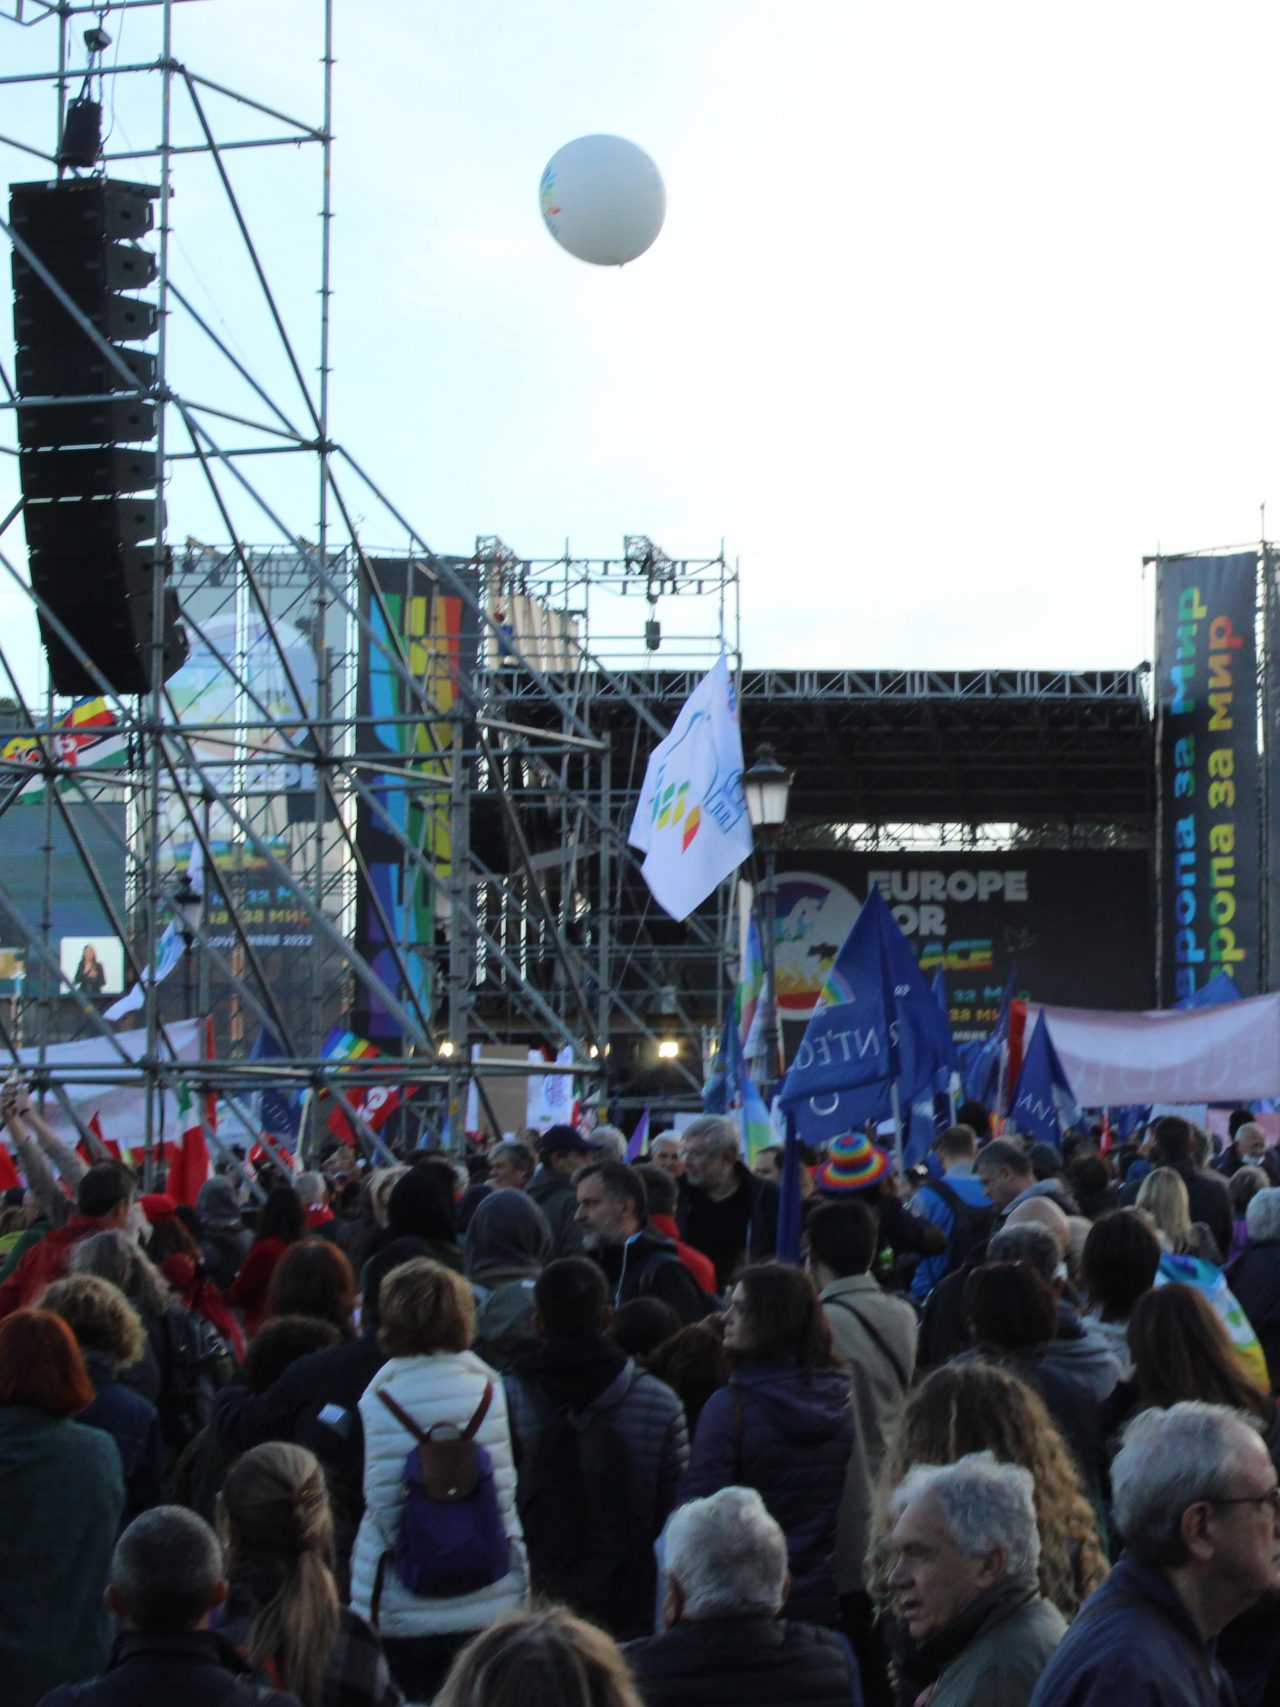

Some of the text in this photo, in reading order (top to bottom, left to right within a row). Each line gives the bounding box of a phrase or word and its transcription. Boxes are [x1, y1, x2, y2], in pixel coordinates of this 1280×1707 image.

[1208, 615, 1244, 731] мир
[1170, 585, 1207, 1000] вропа за Мир
[1207, 748, 1236, 810] за
[867, 870, 1029, 902] EUROPE
[890, 904, 947, 937] OR
[918, 939, 993, 971] ACE
